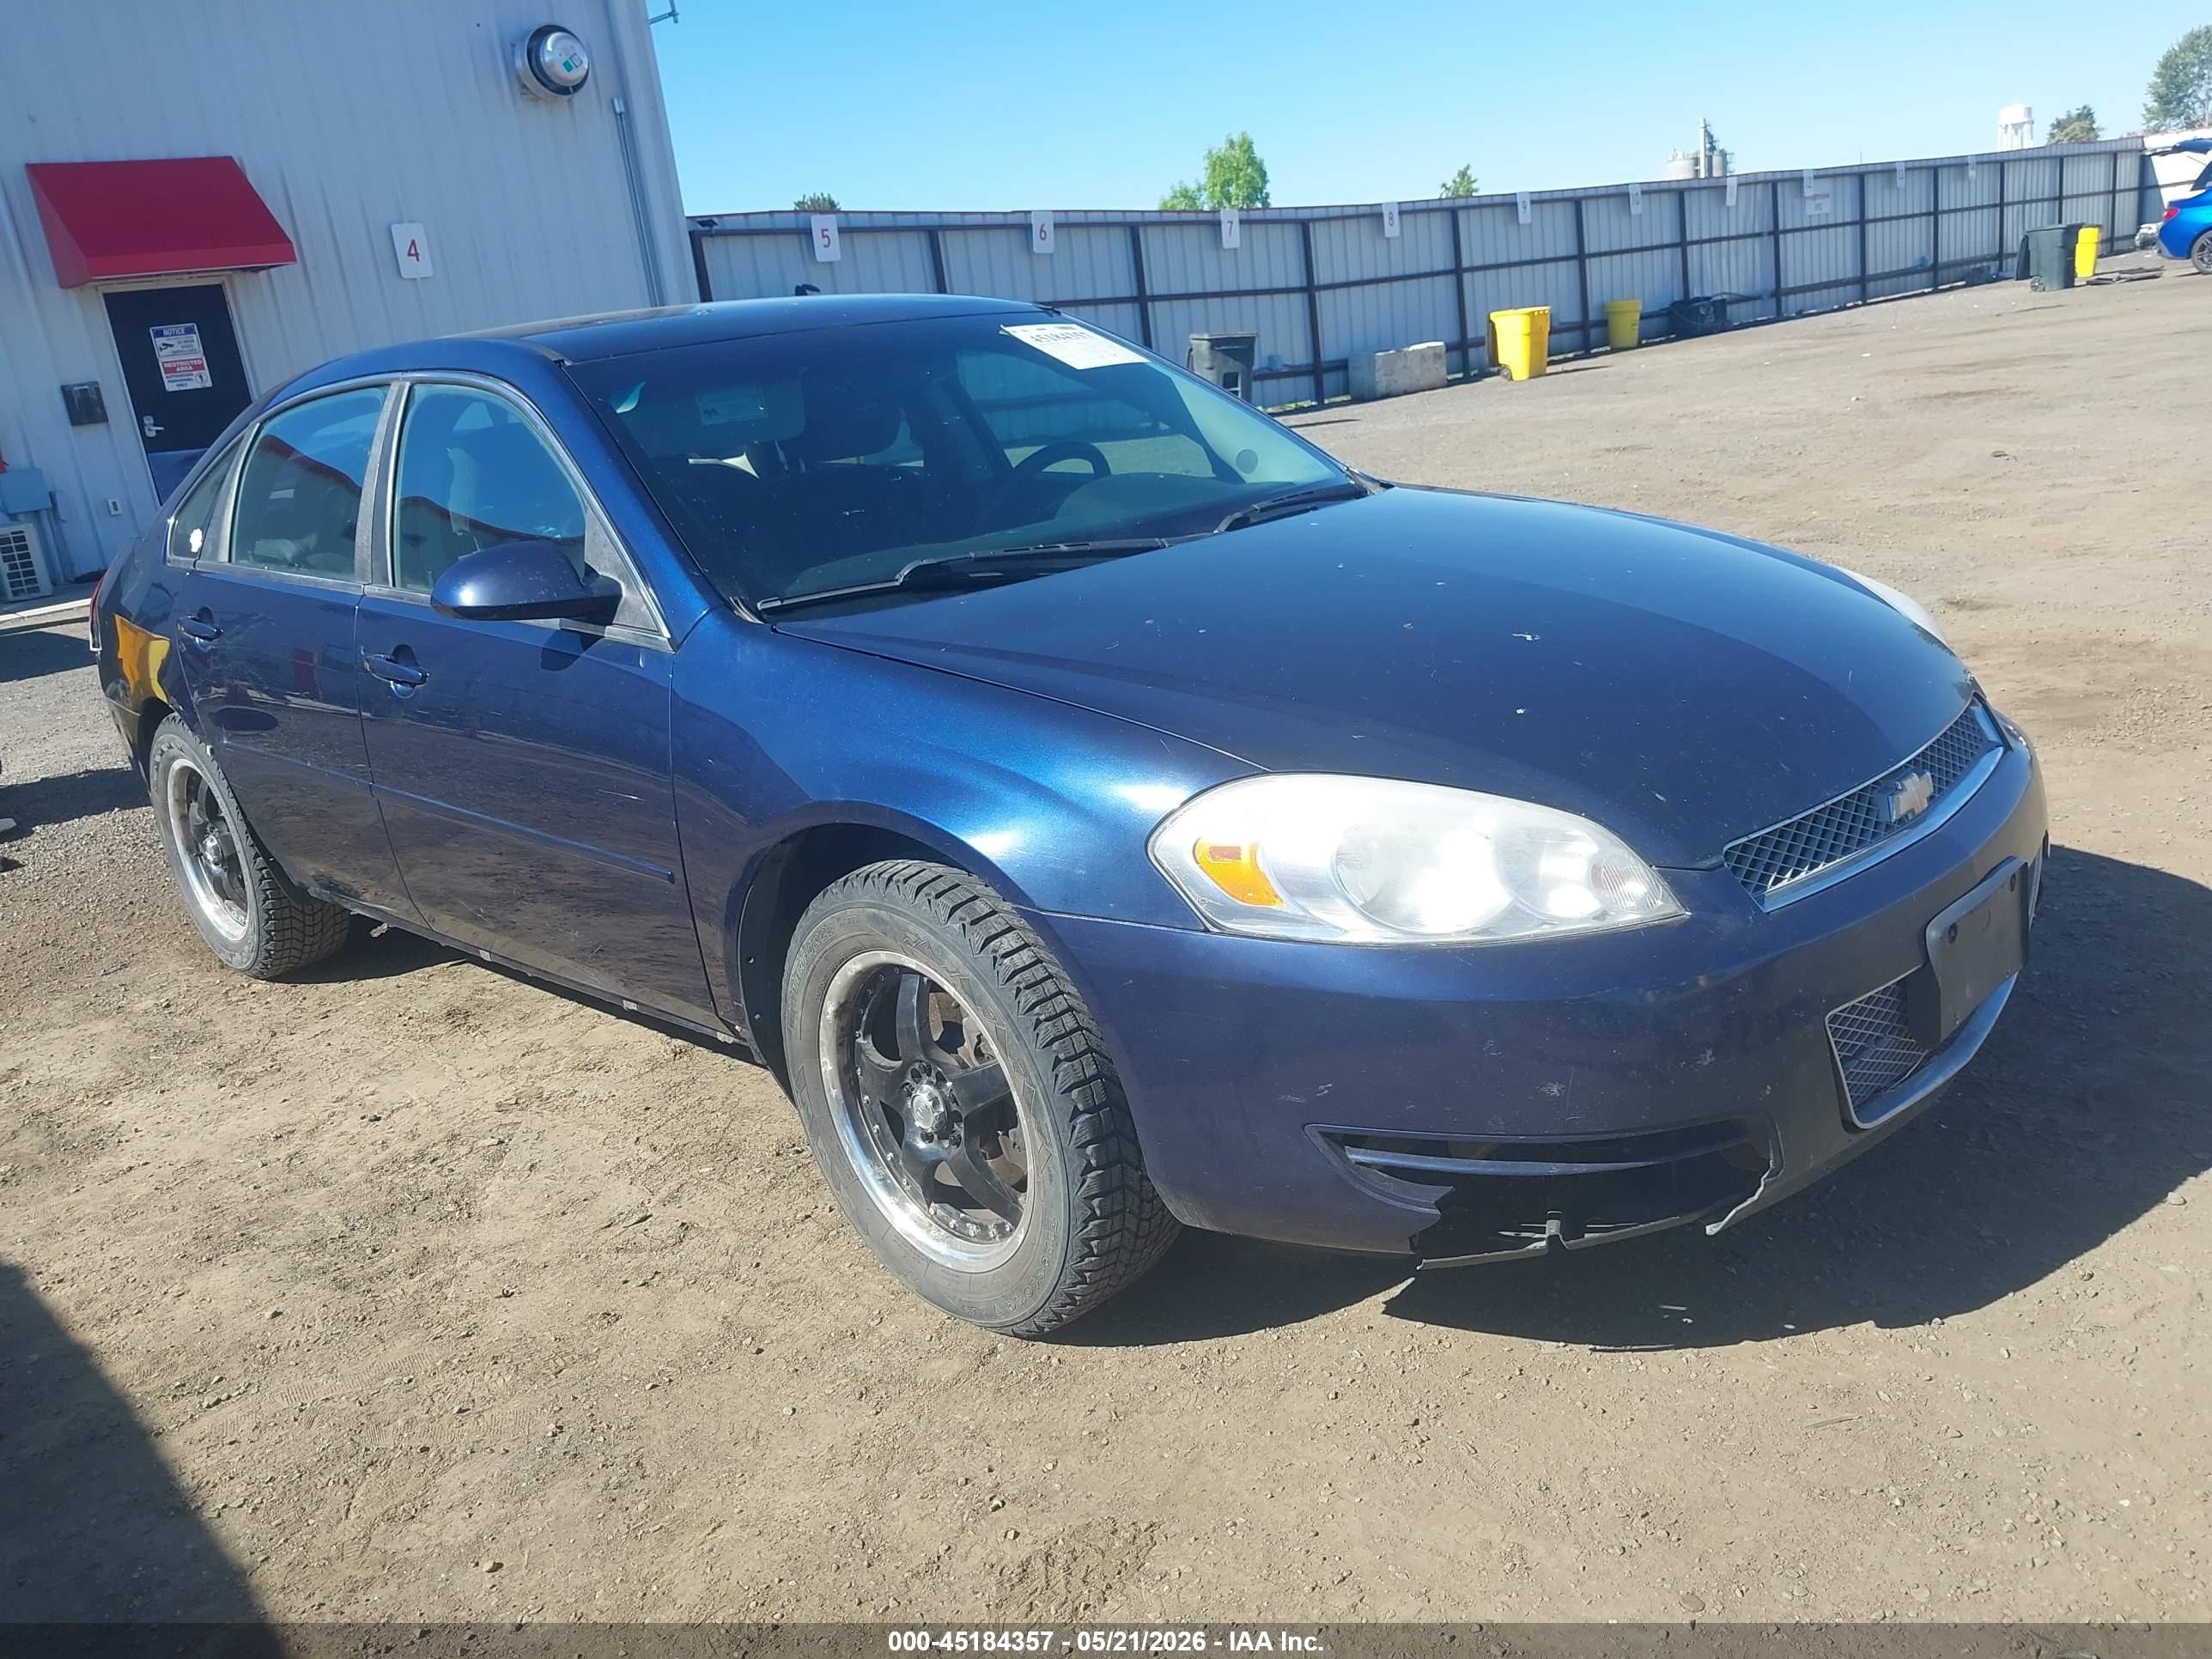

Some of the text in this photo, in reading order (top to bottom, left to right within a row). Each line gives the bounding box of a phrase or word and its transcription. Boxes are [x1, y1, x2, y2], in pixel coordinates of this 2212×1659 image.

[1388, 211, 1395, 227] 8
[820, 228, 831, 248] 5
[1039, 223, 1048, 241] 6
[1226, 220, 1234, 238] 7
[406, 238, 420, 263] 4
[163, 327, 185, 336] NOTICE
